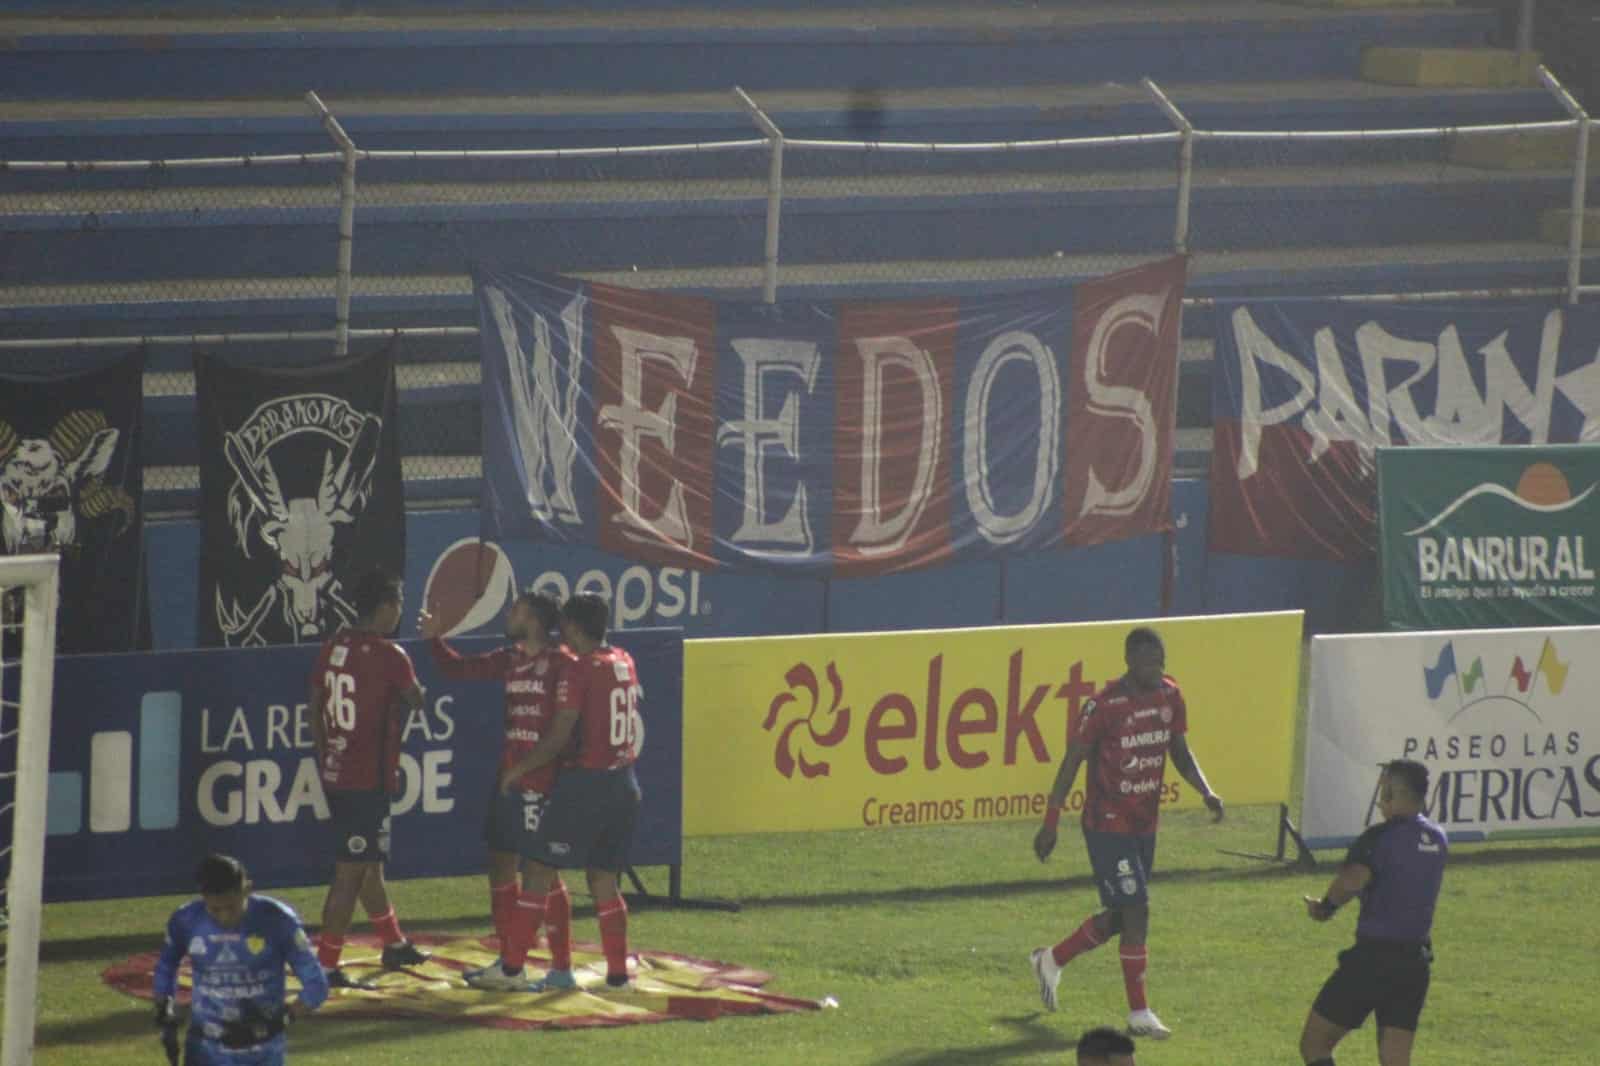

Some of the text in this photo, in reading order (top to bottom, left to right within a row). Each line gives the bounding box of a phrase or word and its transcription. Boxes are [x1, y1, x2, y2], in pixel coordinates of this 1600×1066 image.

[486, 284, 1170, 556] WEEDOS
[1232, 305, 1600, 480] PARAN
[1418, 535, 1594, 581] BANRURAL
[202, 705, 254, 752] LA
[266, 704, 315, 750] RE
[864, 648, 1097, 775] elekt
[1403, 731, 1581, 760] PASEO LAS
[197, 750, 455, 826] GRADE
[863, 791, 964, 827] Creamos
